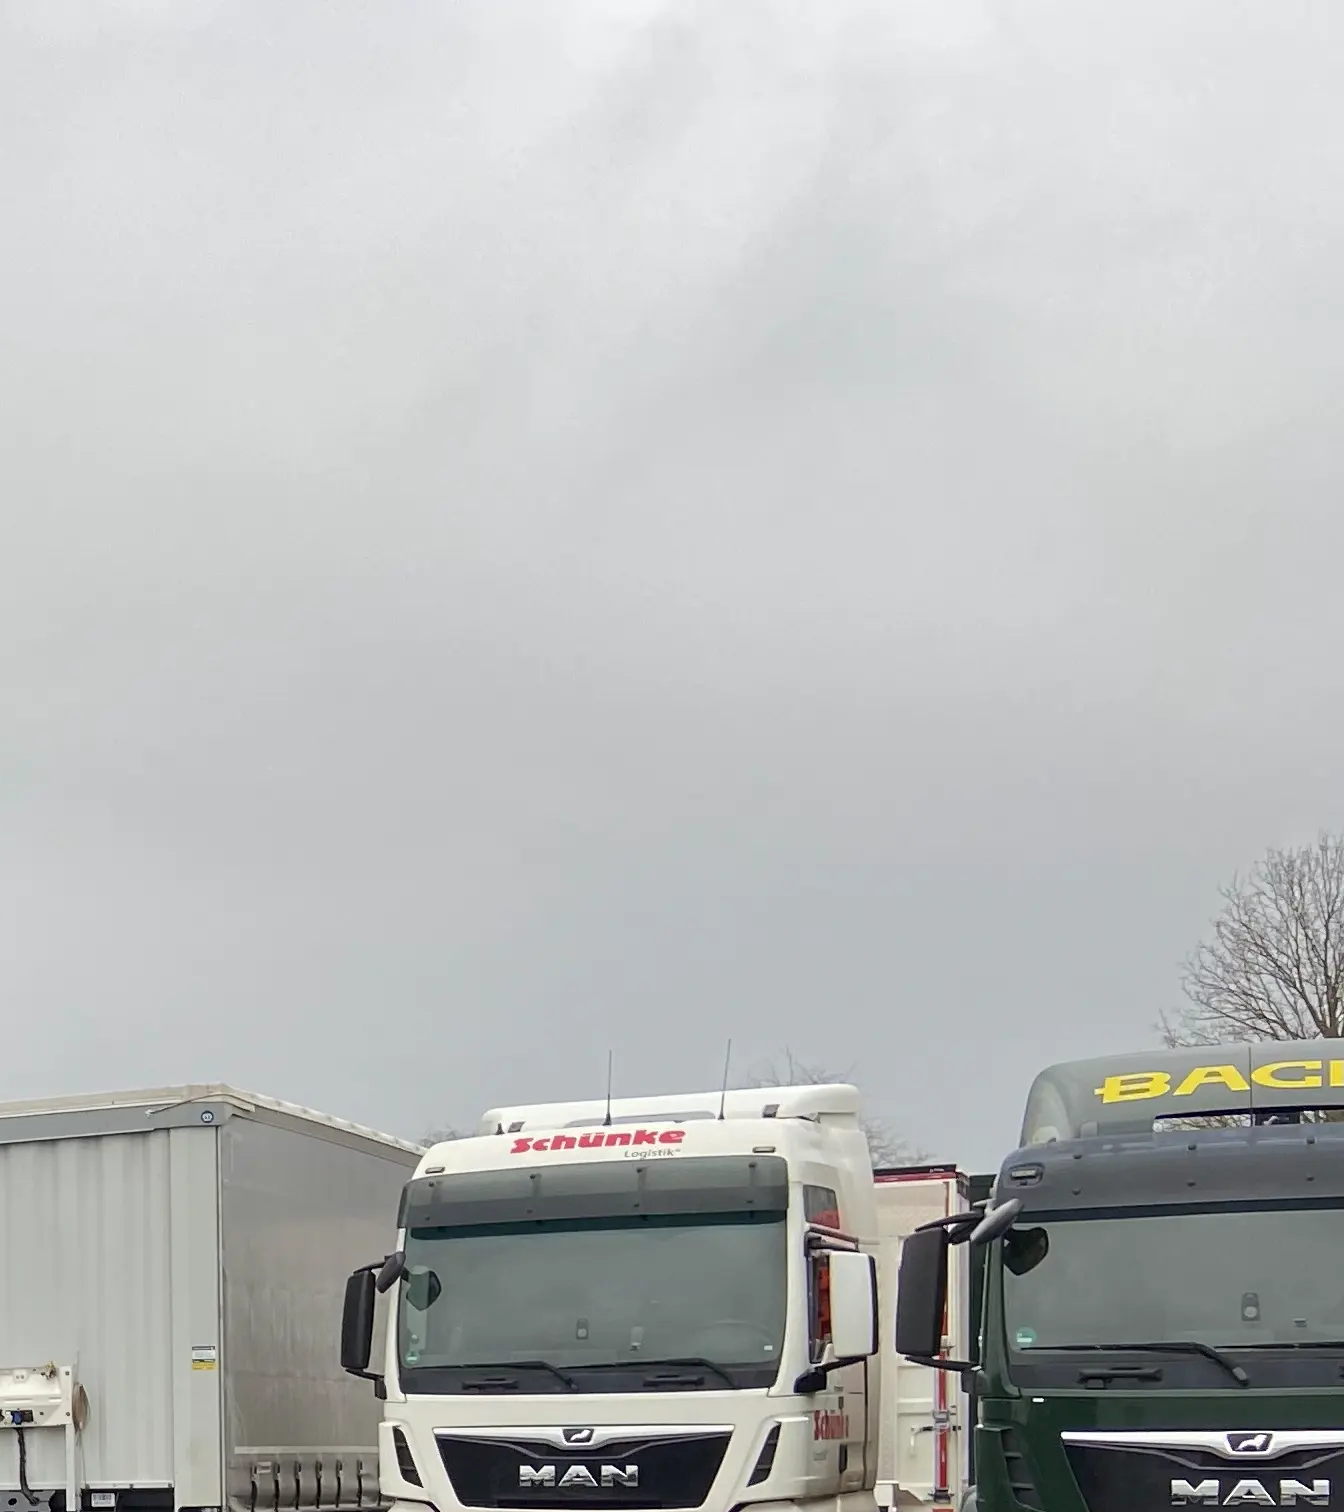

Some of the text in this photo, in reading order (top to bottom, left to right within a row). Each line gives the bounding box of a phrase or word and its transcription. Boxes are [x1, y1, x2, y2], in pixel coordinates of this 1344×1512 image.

[1094, 1060, 1344, 1104] BAC
[510, 1129, 686, 1154] Schünke
[519, 1465, 639, 1487] MAN
[1171, 1479, 1330, 1506] MAN
